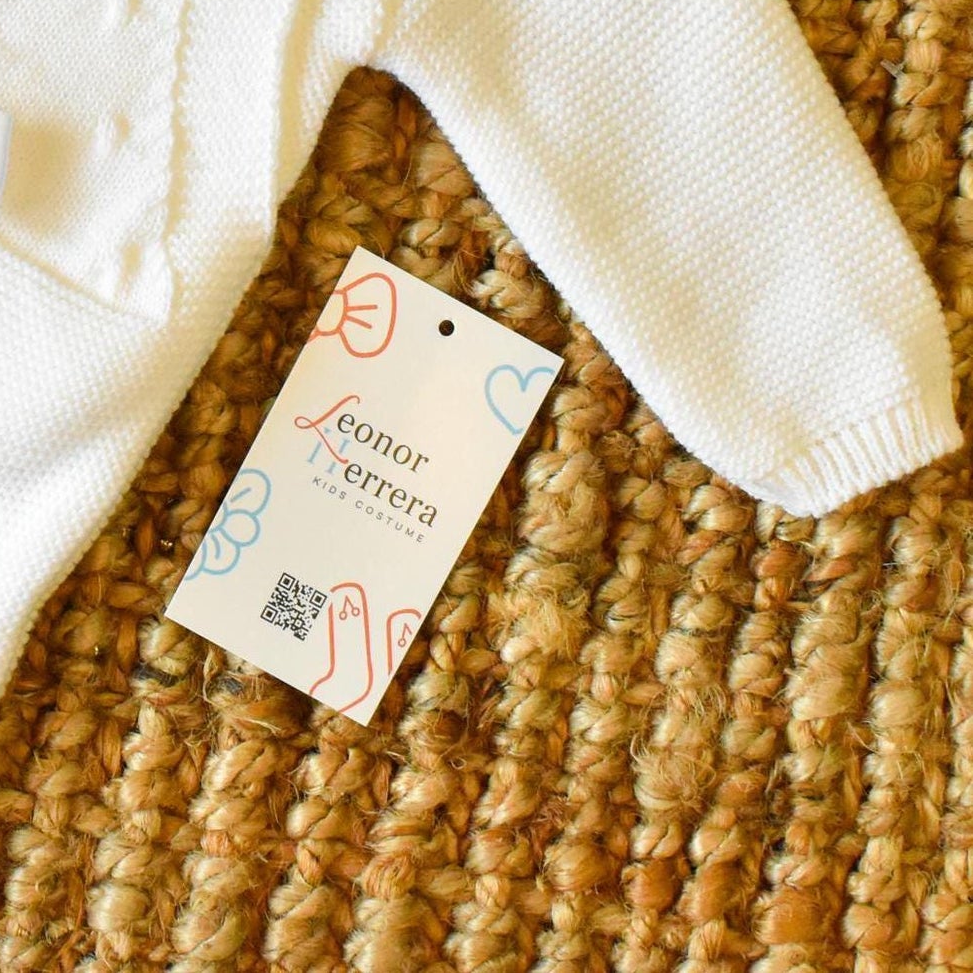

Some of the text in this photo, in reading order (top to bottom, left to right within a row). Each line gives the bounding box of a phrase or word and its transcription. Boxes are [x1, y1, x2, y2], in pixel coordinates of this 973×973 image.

[294, 395, 429, 473] Leonor
[312, 476, 425, 543] KIDS COSTUME
